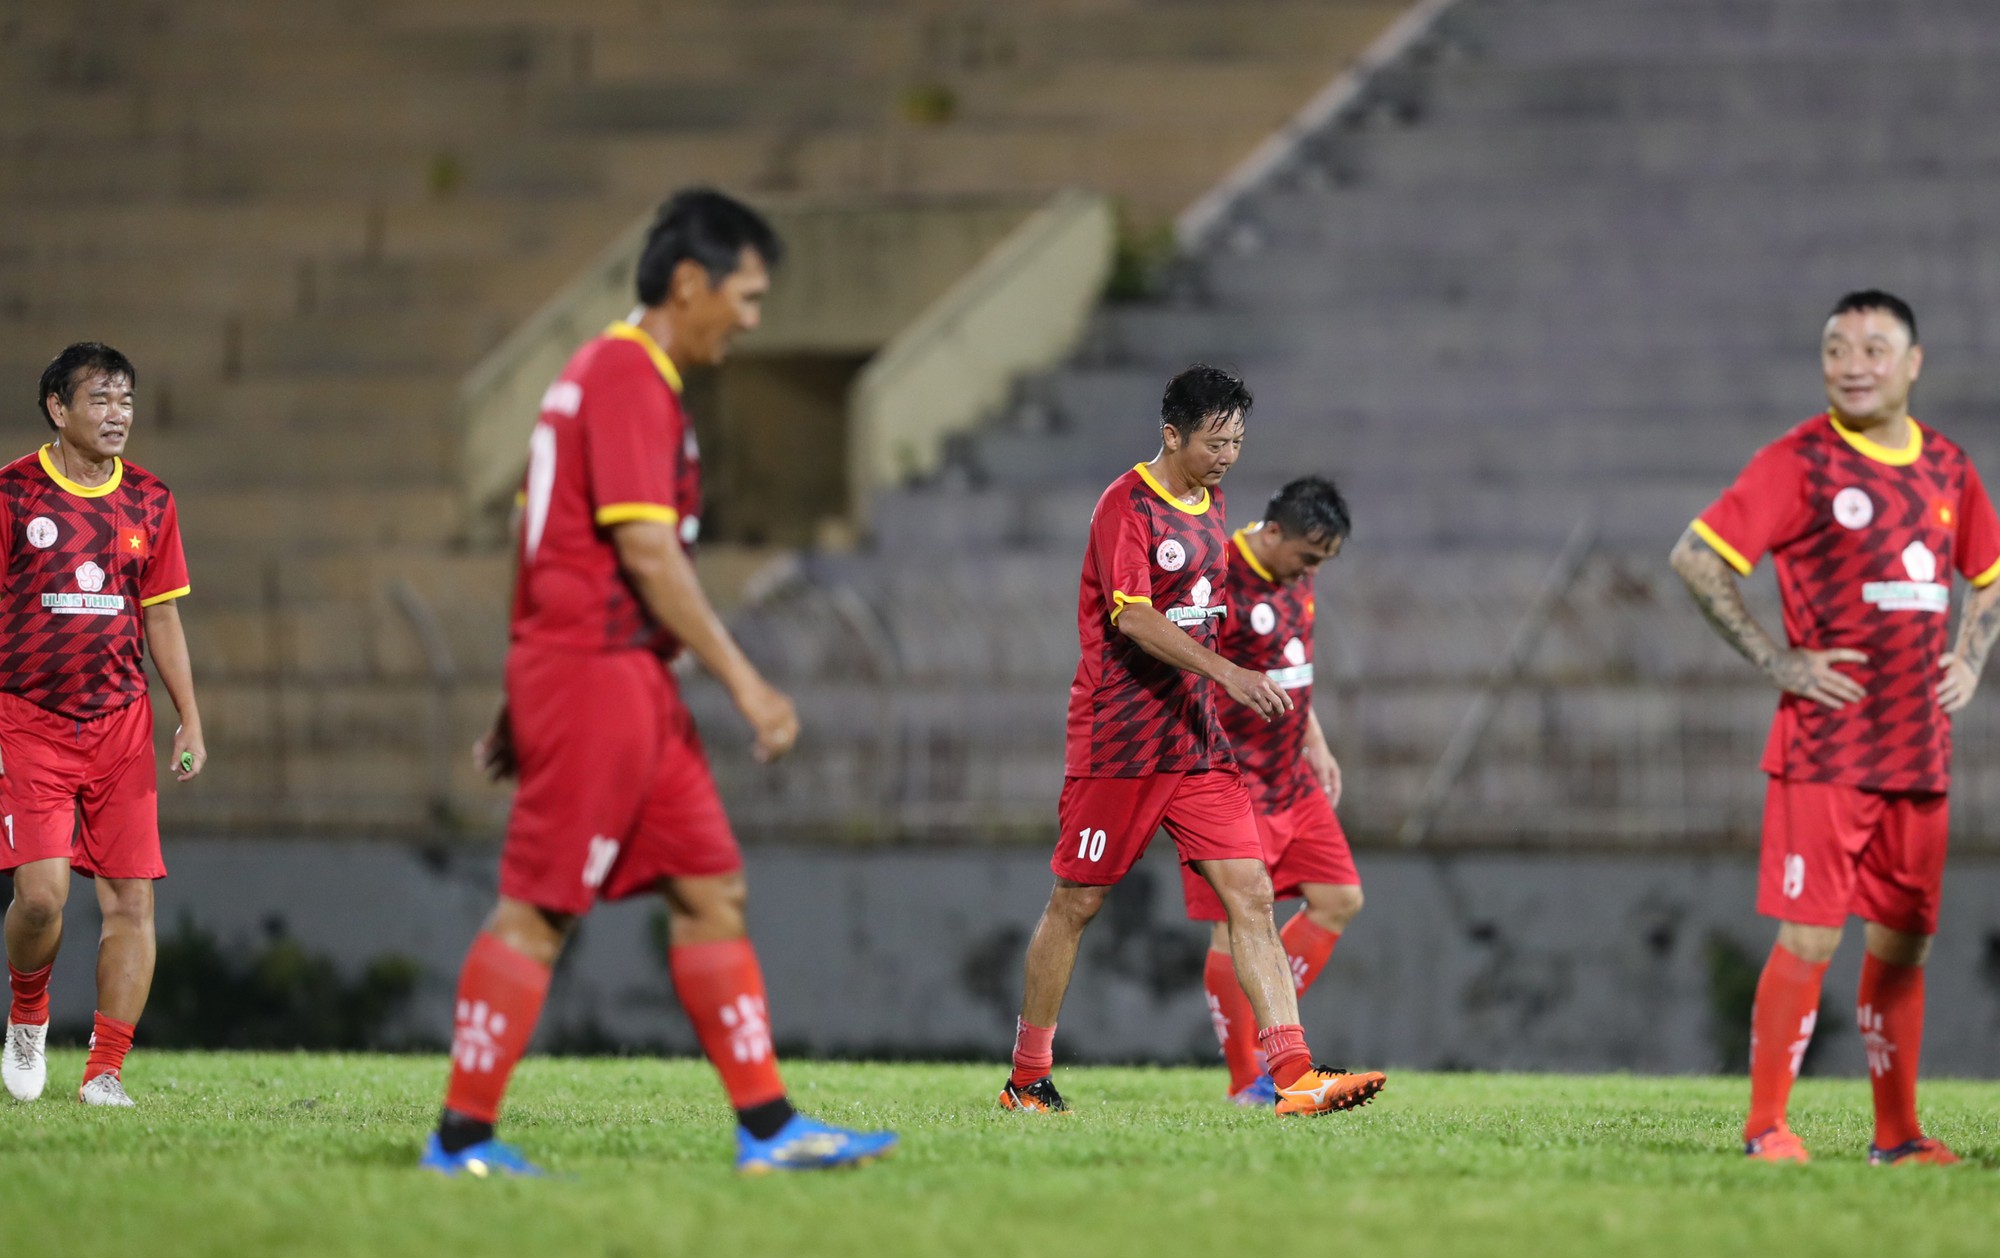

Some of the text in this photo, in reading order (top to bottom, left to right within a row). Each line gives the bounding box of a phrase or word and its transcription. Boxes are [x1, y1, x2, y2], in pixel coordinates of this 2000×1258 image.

[43, 594, 81, 607] HUNG
[1077, 827, 1107, 862] 10
[1783, 853, 1806, 900] 19
